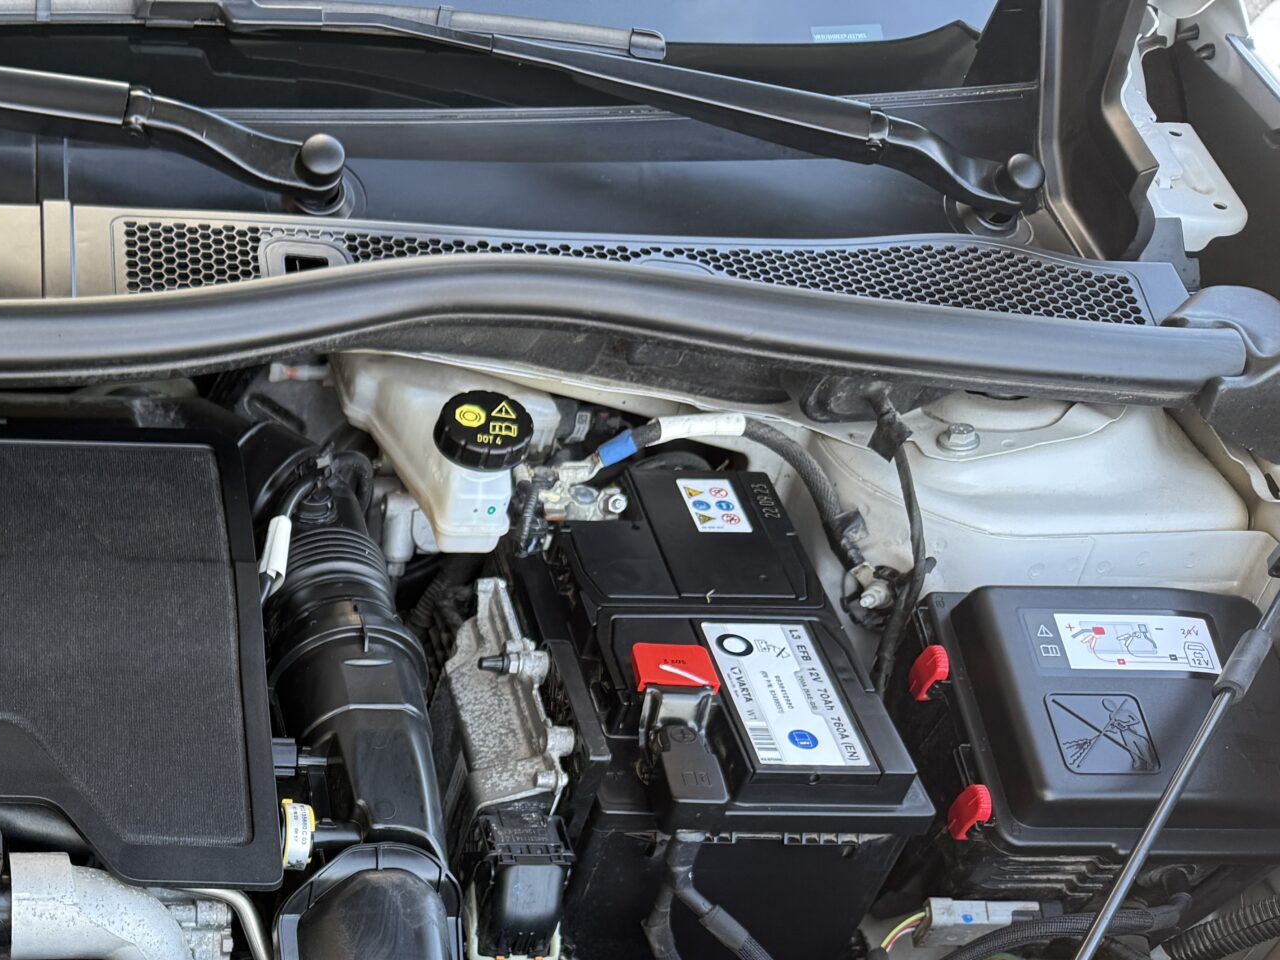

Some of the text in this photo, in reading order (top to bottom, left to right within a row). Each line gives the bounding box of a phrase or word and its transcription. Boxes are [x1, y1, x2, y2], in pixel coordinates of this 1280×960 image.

[477, 433, 503, 446] DOT 4
[735, 675, 753, 703] VARTA
[789, 629, 861, 761] L3 EFB 12V 70Ah 760A (EN)
